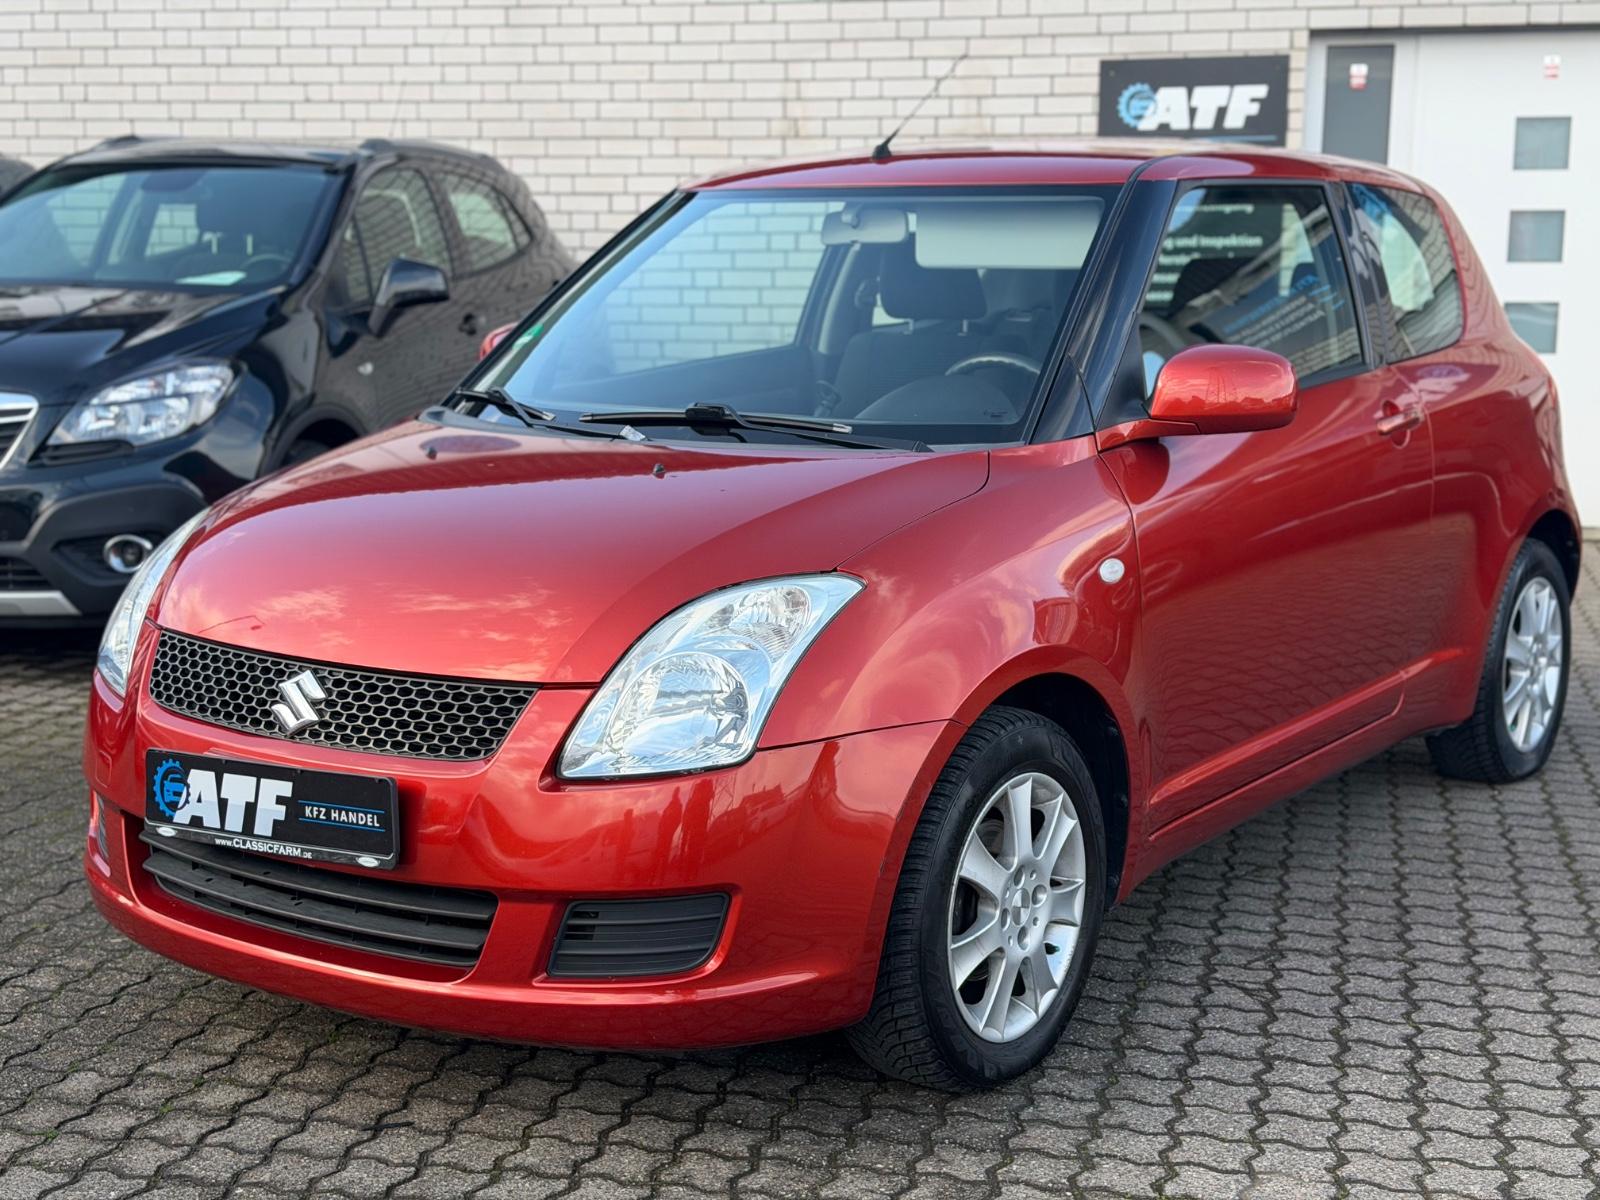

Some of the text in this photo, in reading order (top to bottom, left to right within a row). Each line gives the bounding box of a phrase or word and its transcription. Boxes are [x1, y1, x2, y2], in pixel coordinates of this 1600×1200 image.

[1137, 84, 1269, 131] ATF
[172, 768, 380, 837] ATF KFZ HANDEL
